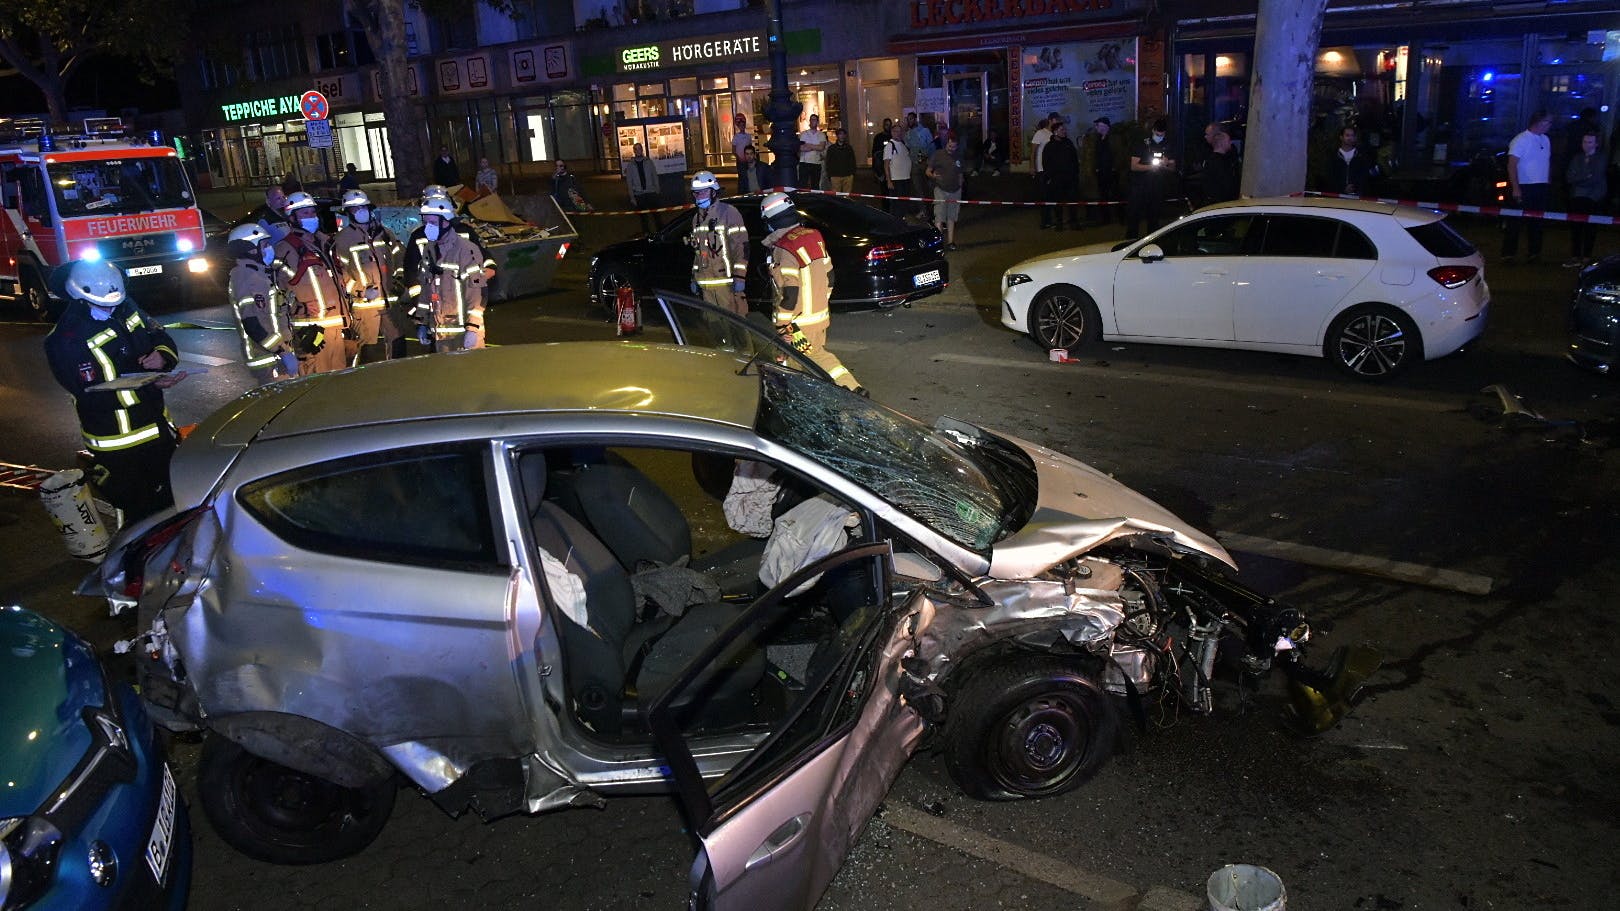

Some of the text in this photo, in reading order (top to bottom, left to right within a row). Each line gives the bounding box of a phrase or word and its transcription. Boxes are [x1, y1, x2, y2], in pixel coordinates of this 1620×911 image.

[622, 46, 660, 64] GEERS
[672, 36, 760, 62] HÖRGERÄTE
[221, 94, 304, 121] TEPPICHE AYA
[87, 214, 177, 236] FEUERWEHR
[122, 239, 155, 249] MAN
